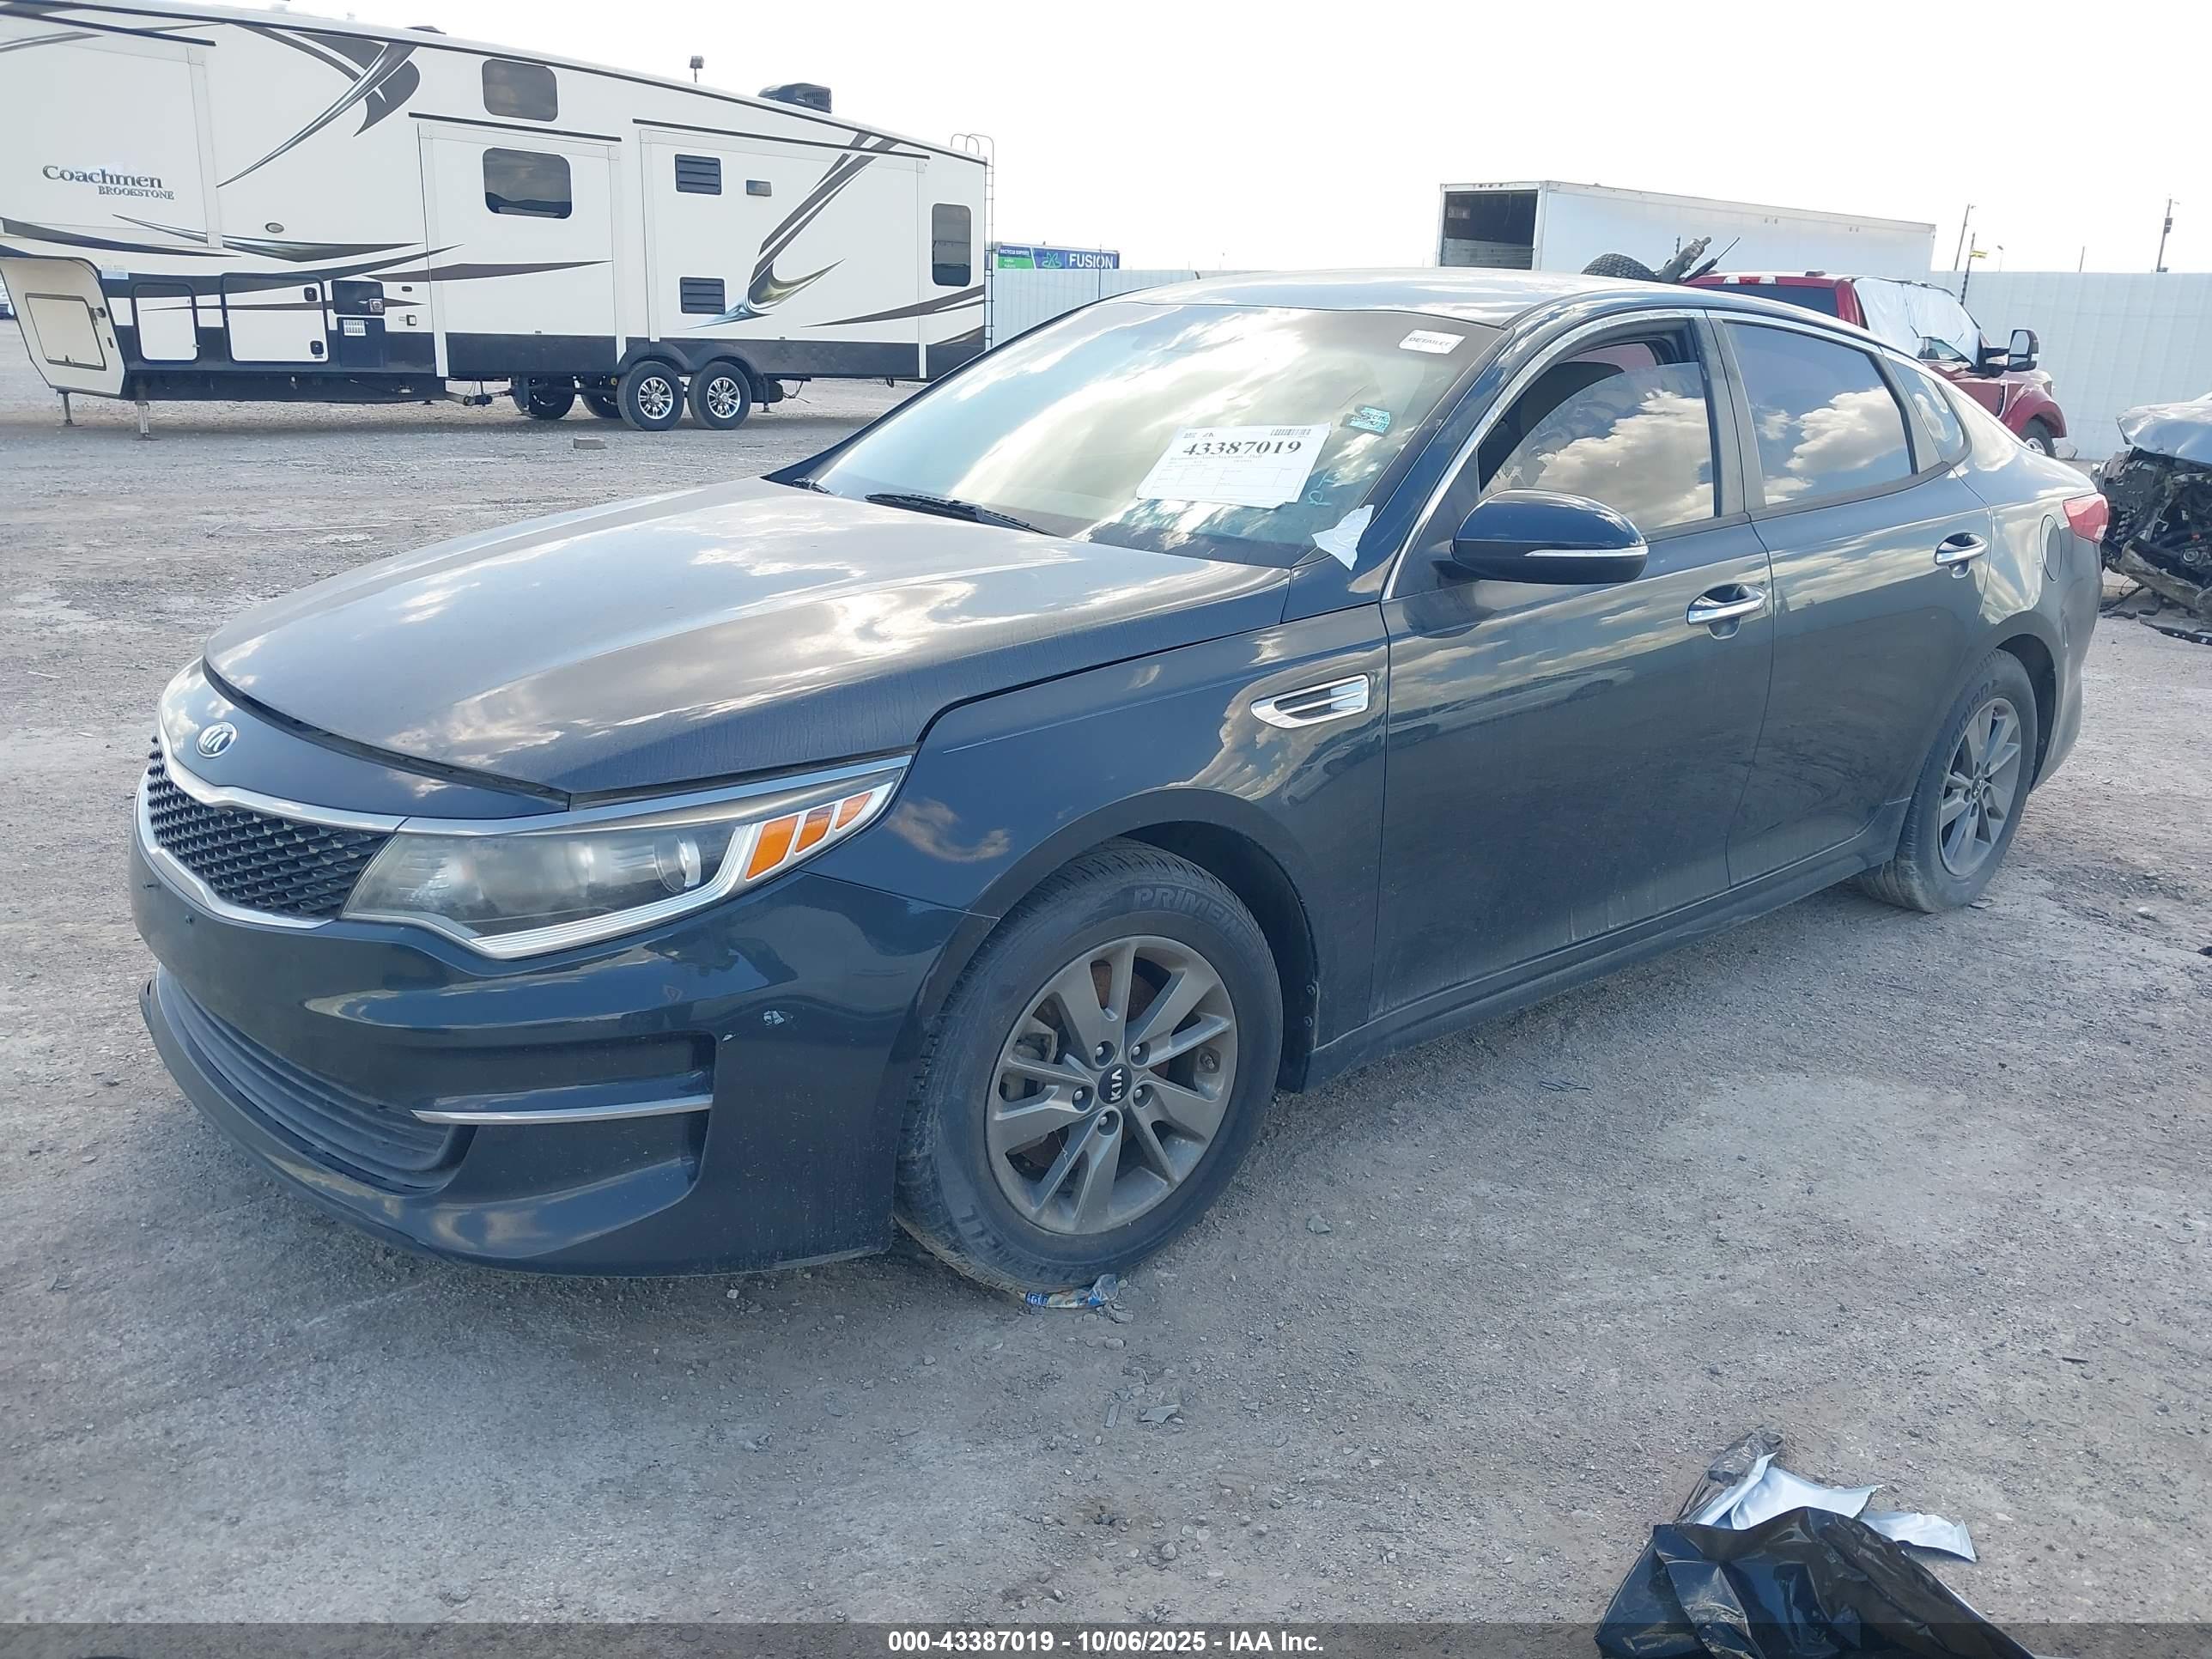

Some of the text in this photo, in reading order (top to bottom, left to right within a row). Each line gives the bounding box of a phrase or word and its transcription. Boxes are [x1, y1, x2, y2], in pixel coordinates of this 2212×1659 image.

[42, 165, 163, 188] Coachmen
[98, 185, 174, 200] BROOKSTONE
[1069, 253, 1114, 270] FUSION
[1182, 441, 1302, 456] 43387019
[1109, 1067, 1122, 1101] KIA
